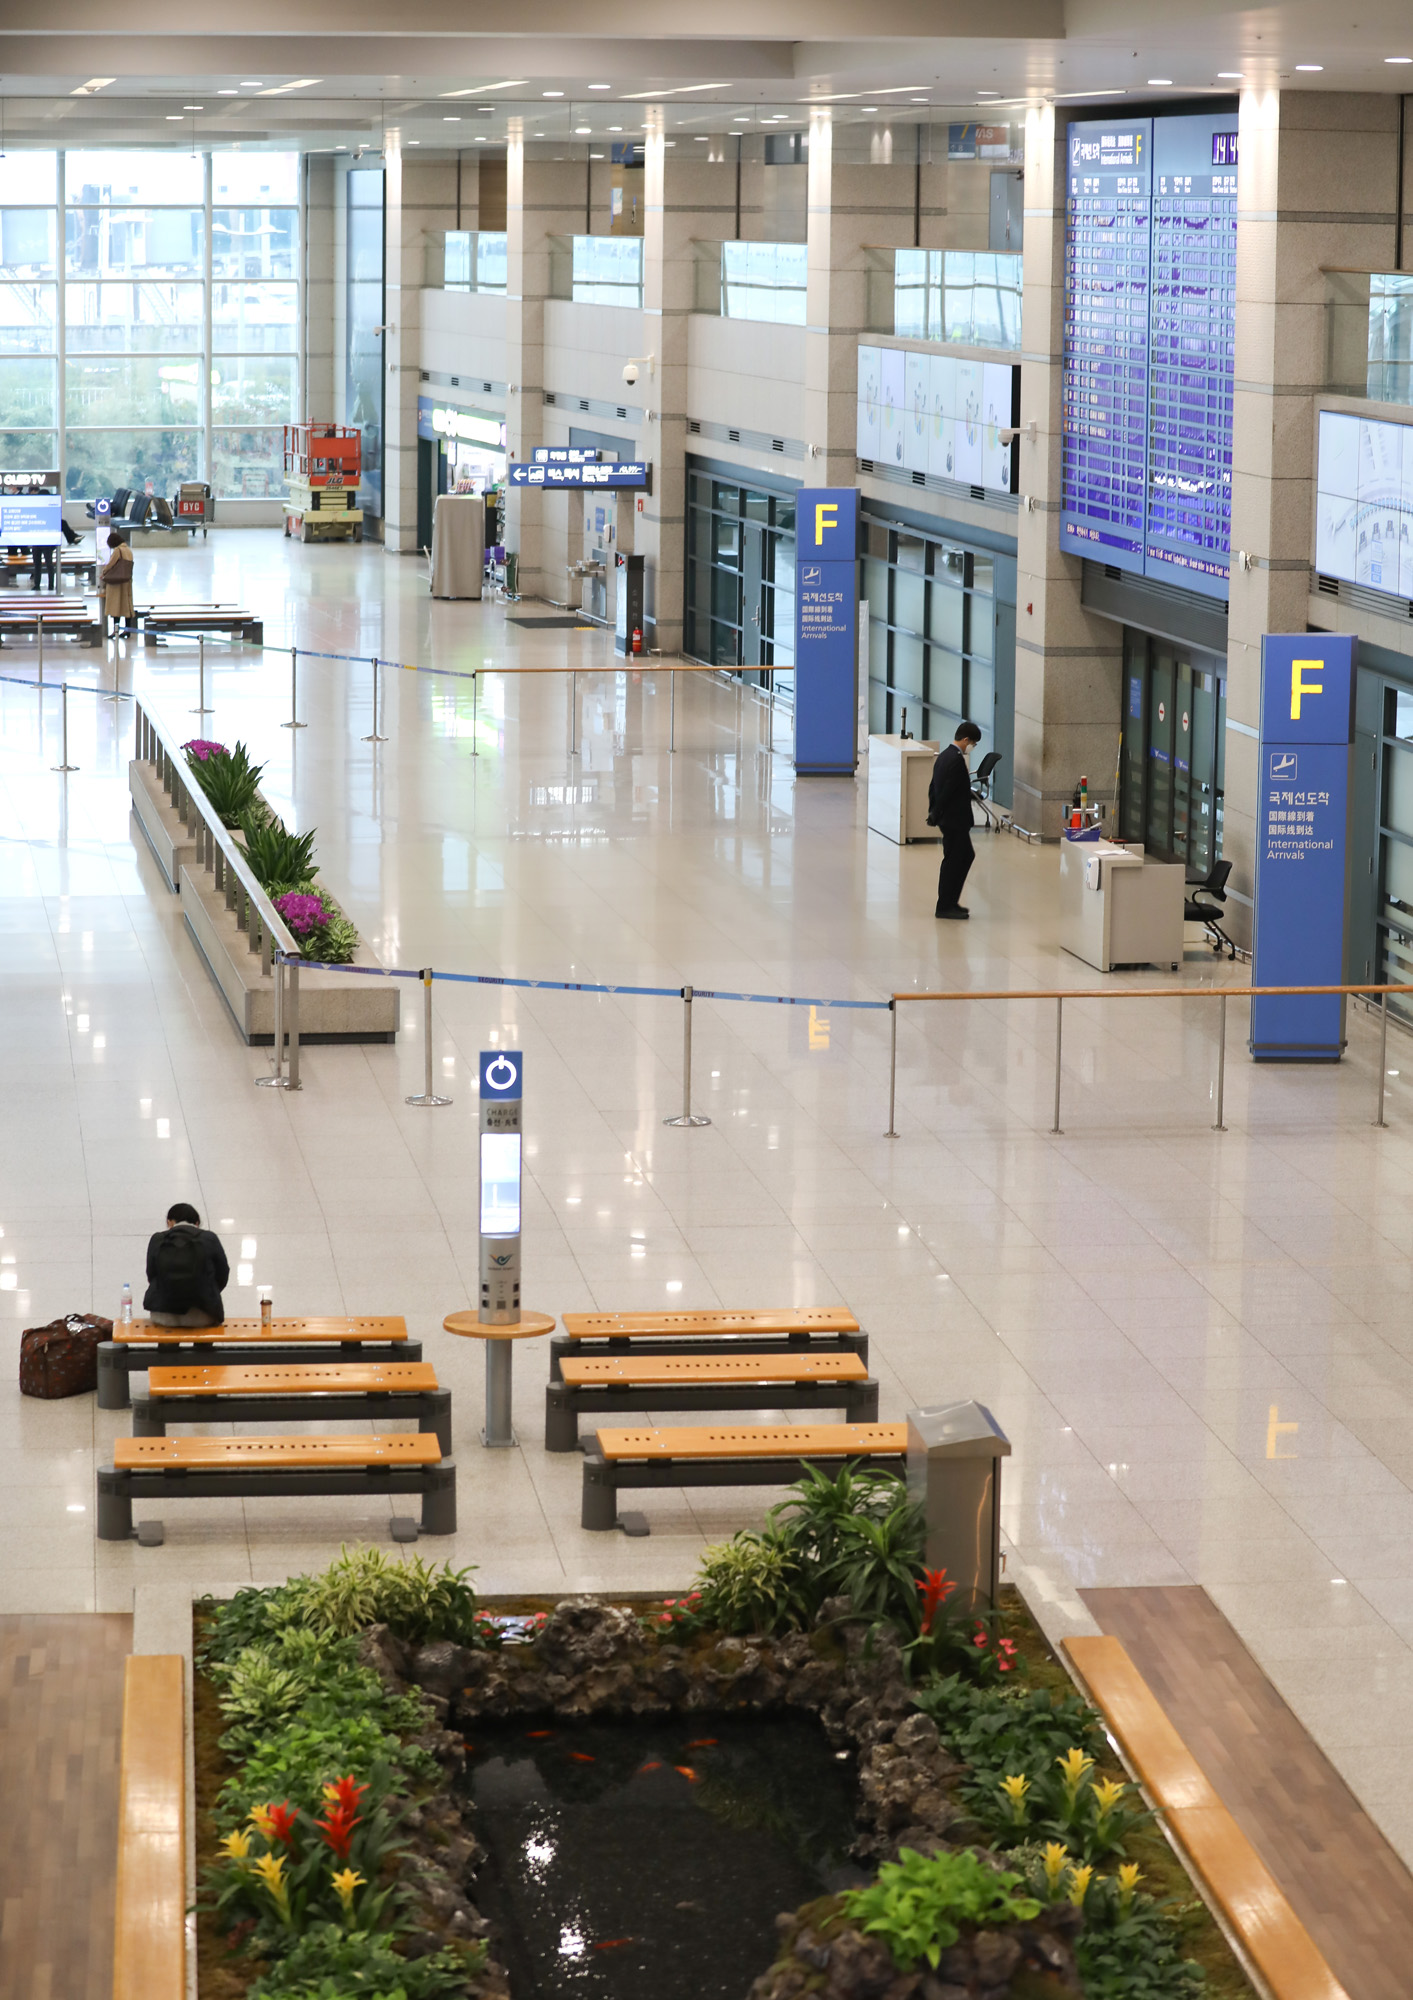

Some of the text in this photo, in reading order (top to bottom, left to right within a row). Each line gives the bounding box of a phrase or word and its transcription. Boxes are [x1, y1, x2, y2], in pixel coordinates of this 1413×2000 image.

[1136, 134, 1142, 164] F
[31, 474, 46, 485] TV
[815, 504, 838, 546] F
[802, 592, 843, 602] 국제선도착
[802, 624, 846, 632] International
[1290, 660, 1324, 720] F
[1269, 792, 1330, 806] 국제선도착
[1268, 810, 1314, 822] 国際線到着
[1268, 824, 1314, 836] 国际线到达
[1268, 839, 1334, 849] International
[1266, 850, 1304, 860] Arrivals
[478, 976, 504, 984] SECURITY
[486, 1108, 518, 1116] CHARGE
